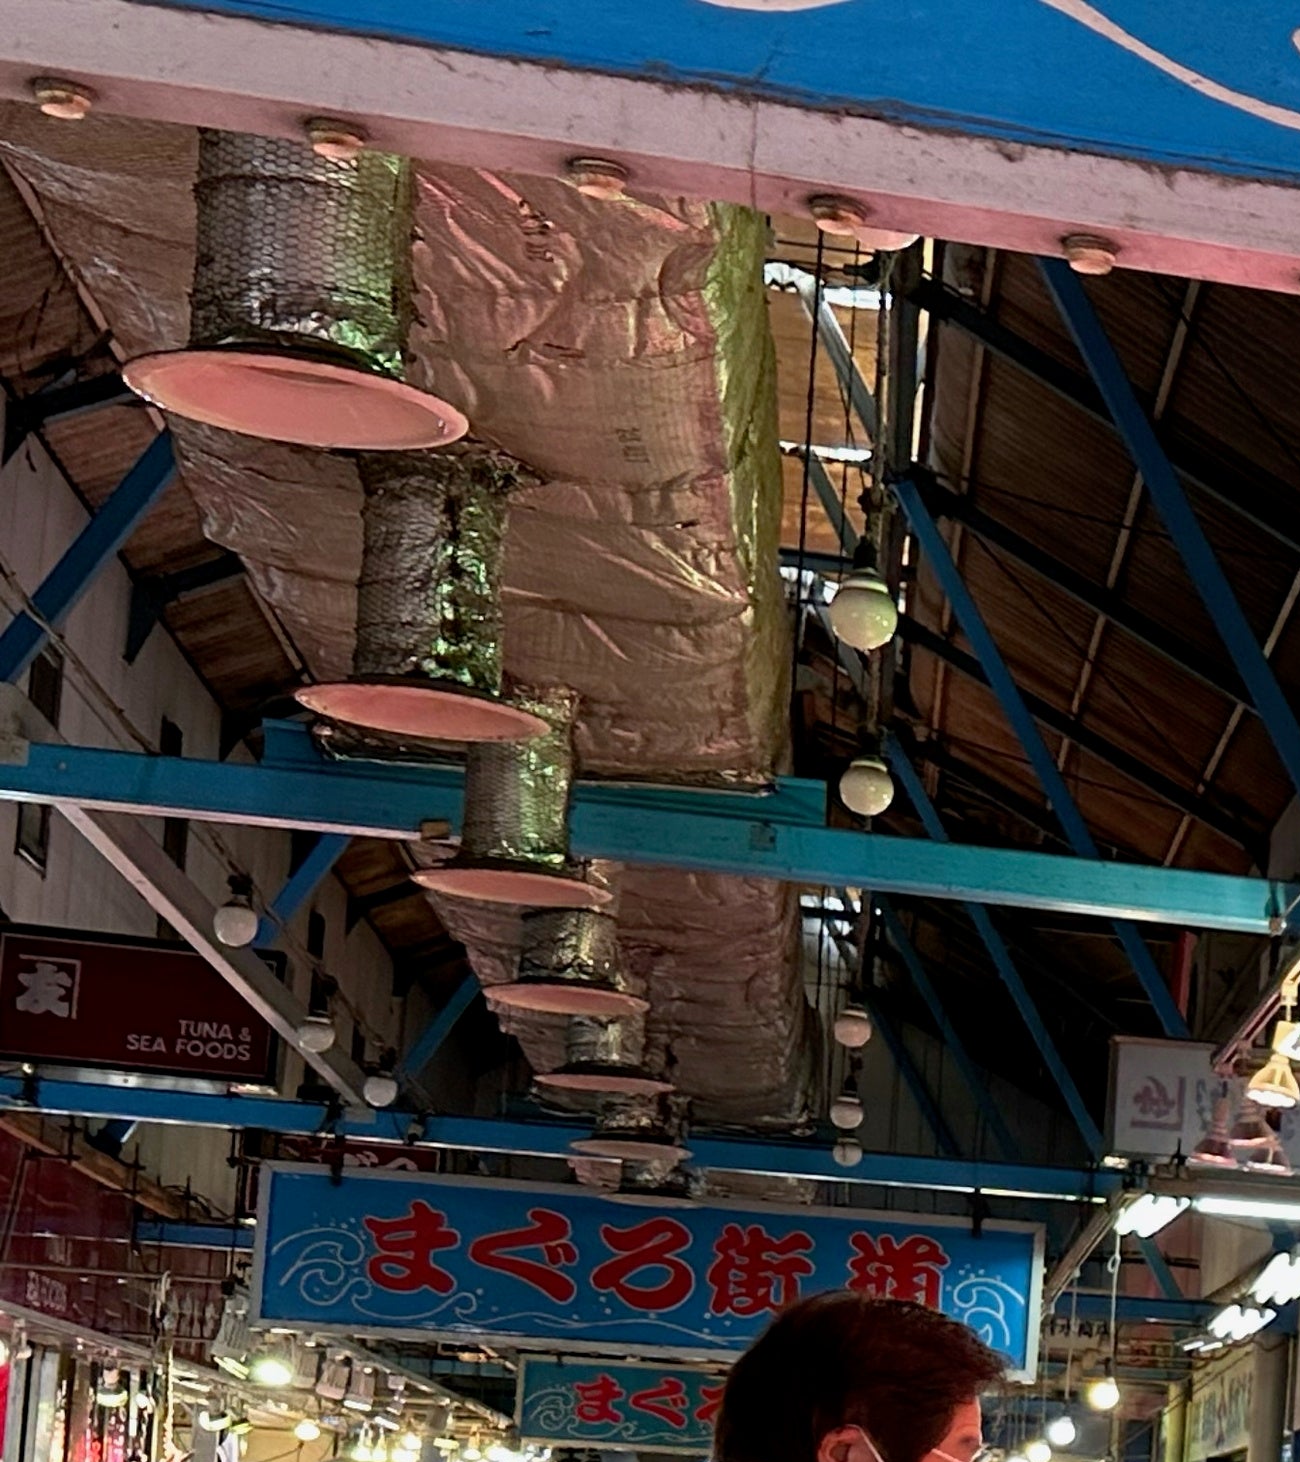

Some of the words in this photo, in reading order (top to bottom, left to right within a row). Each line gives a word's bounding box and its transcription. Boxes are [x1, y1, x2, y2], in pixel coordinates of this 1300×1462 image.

[179, 1020, 232, 1040] TUNA
[238, 1028, 251, 1042] &
[126, 1034, 166, 1053] SEA
[176, 1039, 250, 1061] FOODS
[572, 1374, 724, 1429] まぐ
